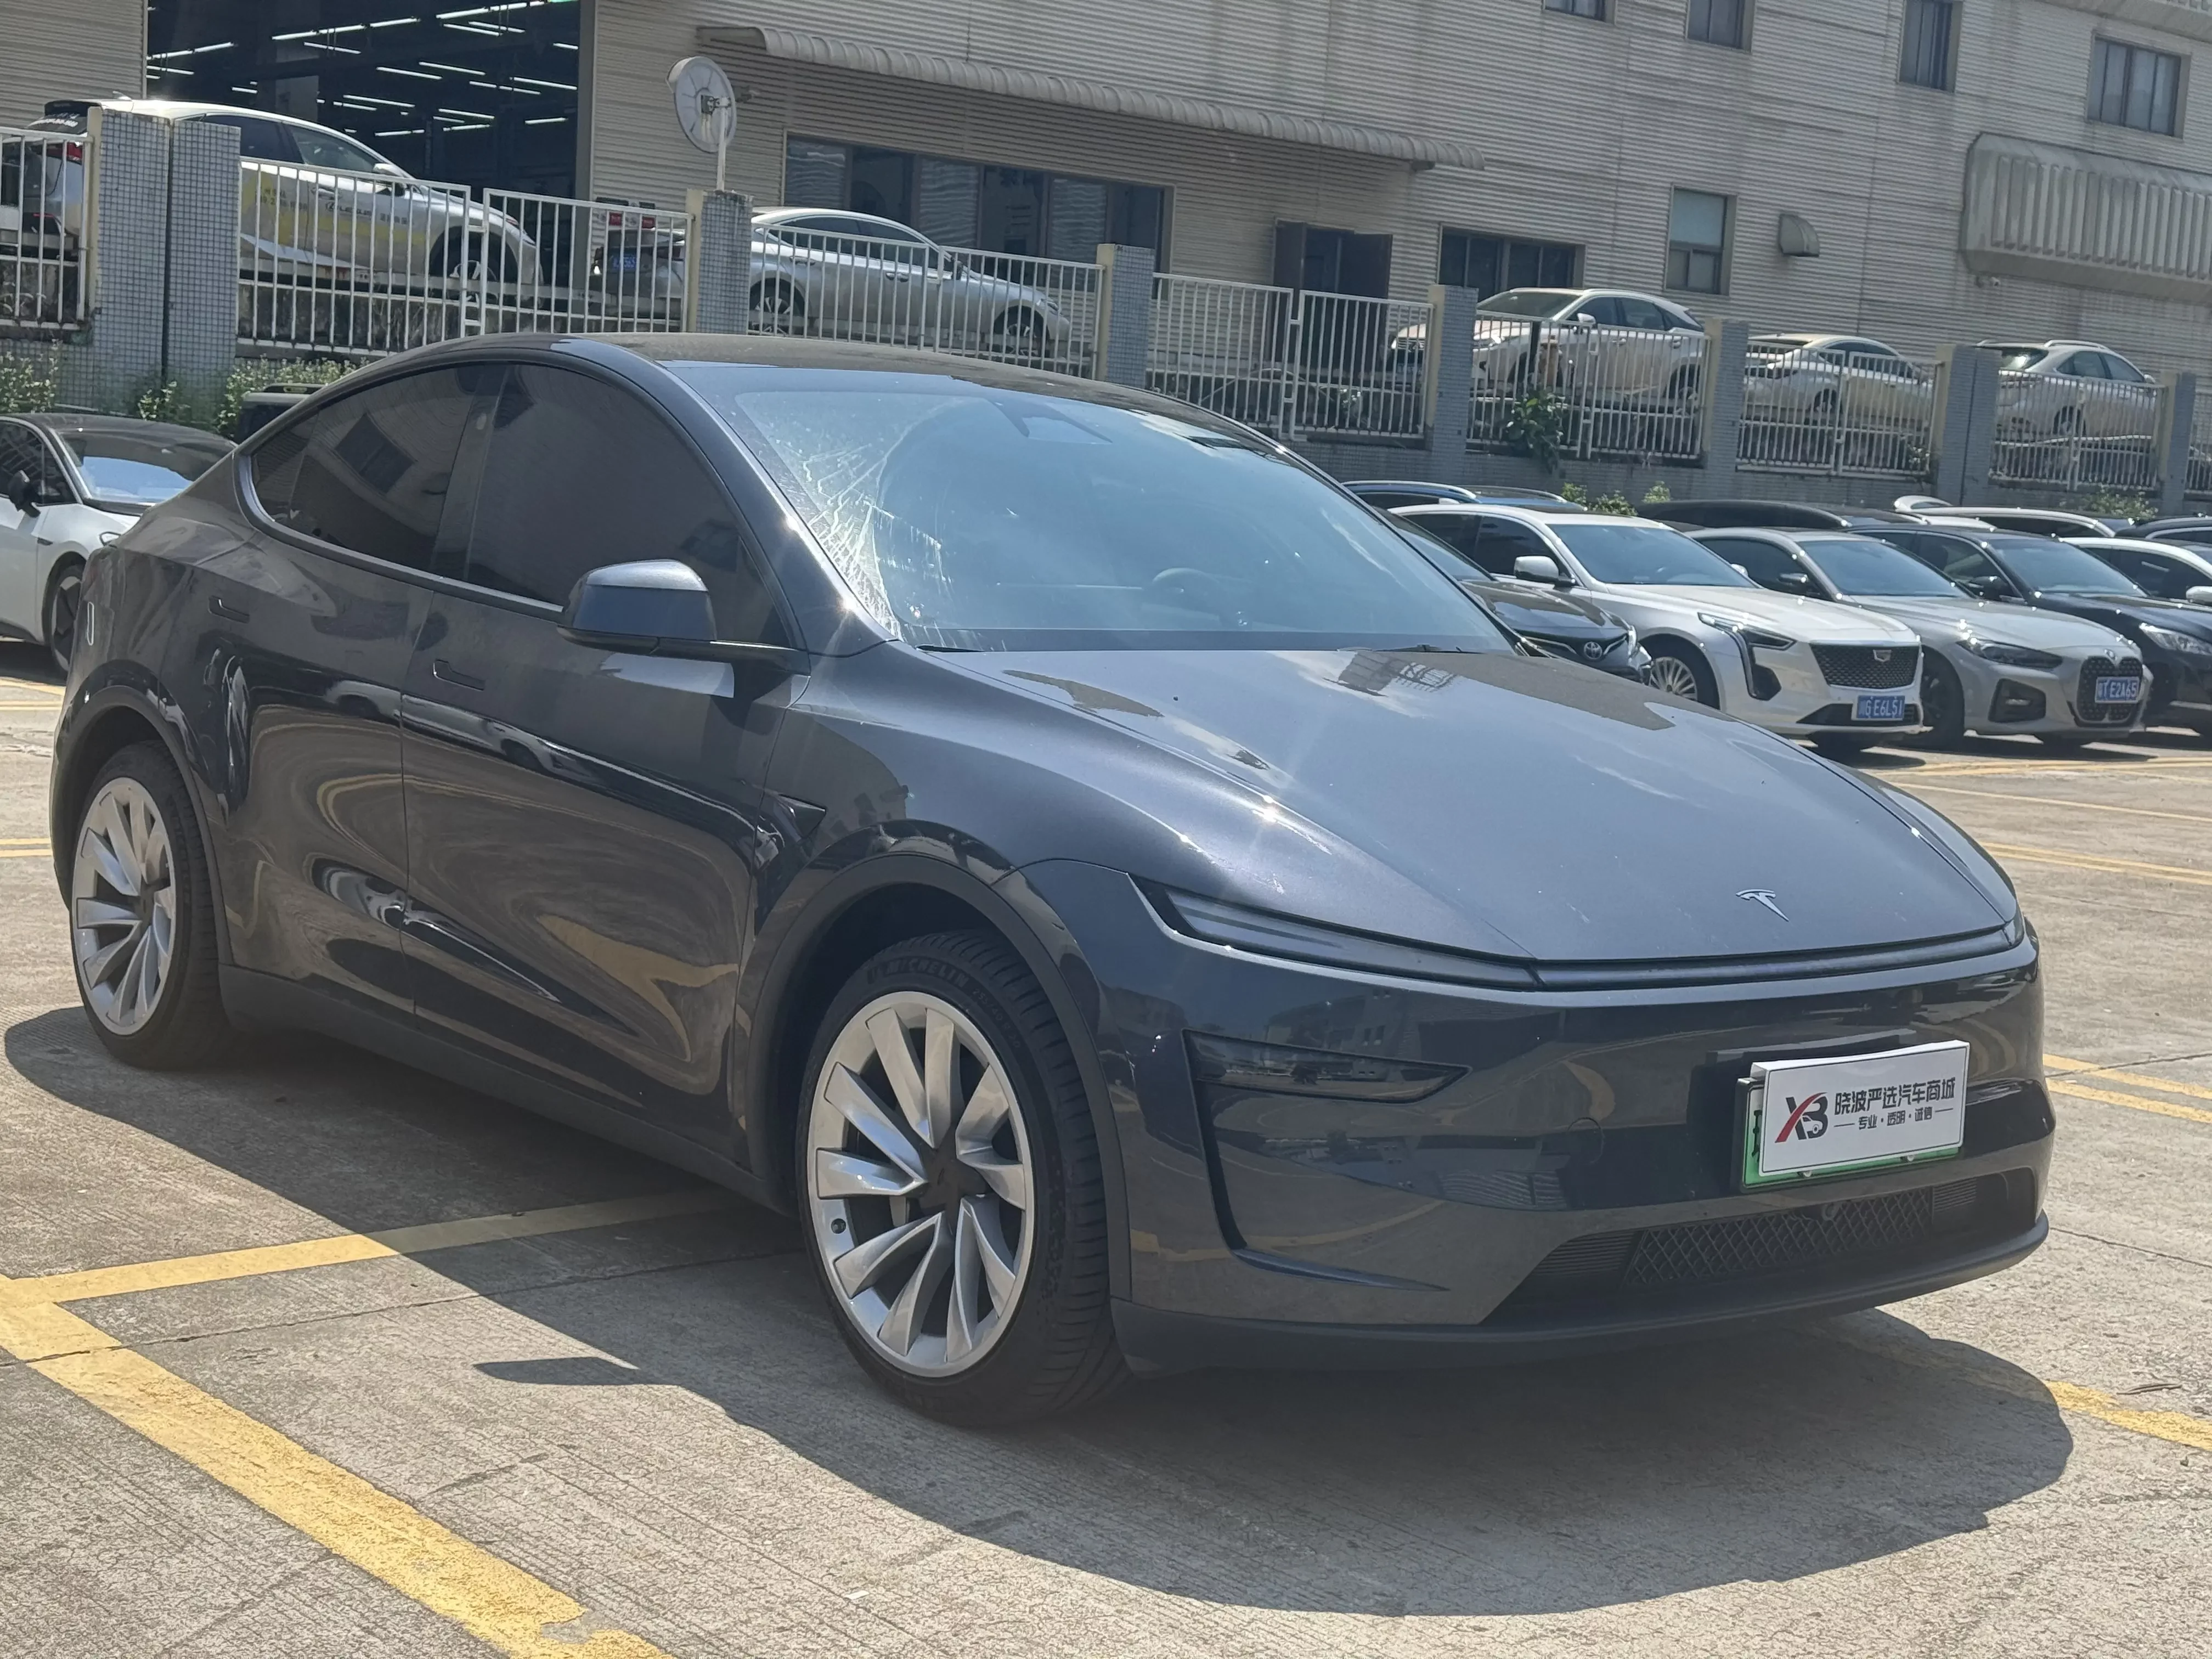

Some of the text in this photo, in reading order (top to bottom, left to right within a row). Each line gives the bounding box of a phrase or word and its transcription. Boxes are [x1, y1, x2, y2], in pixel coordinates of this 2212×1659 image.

[885, 957, 969, 987] MICHELIN
[1834, 1076, 1956, 1116] 晓波严选汽车商城
